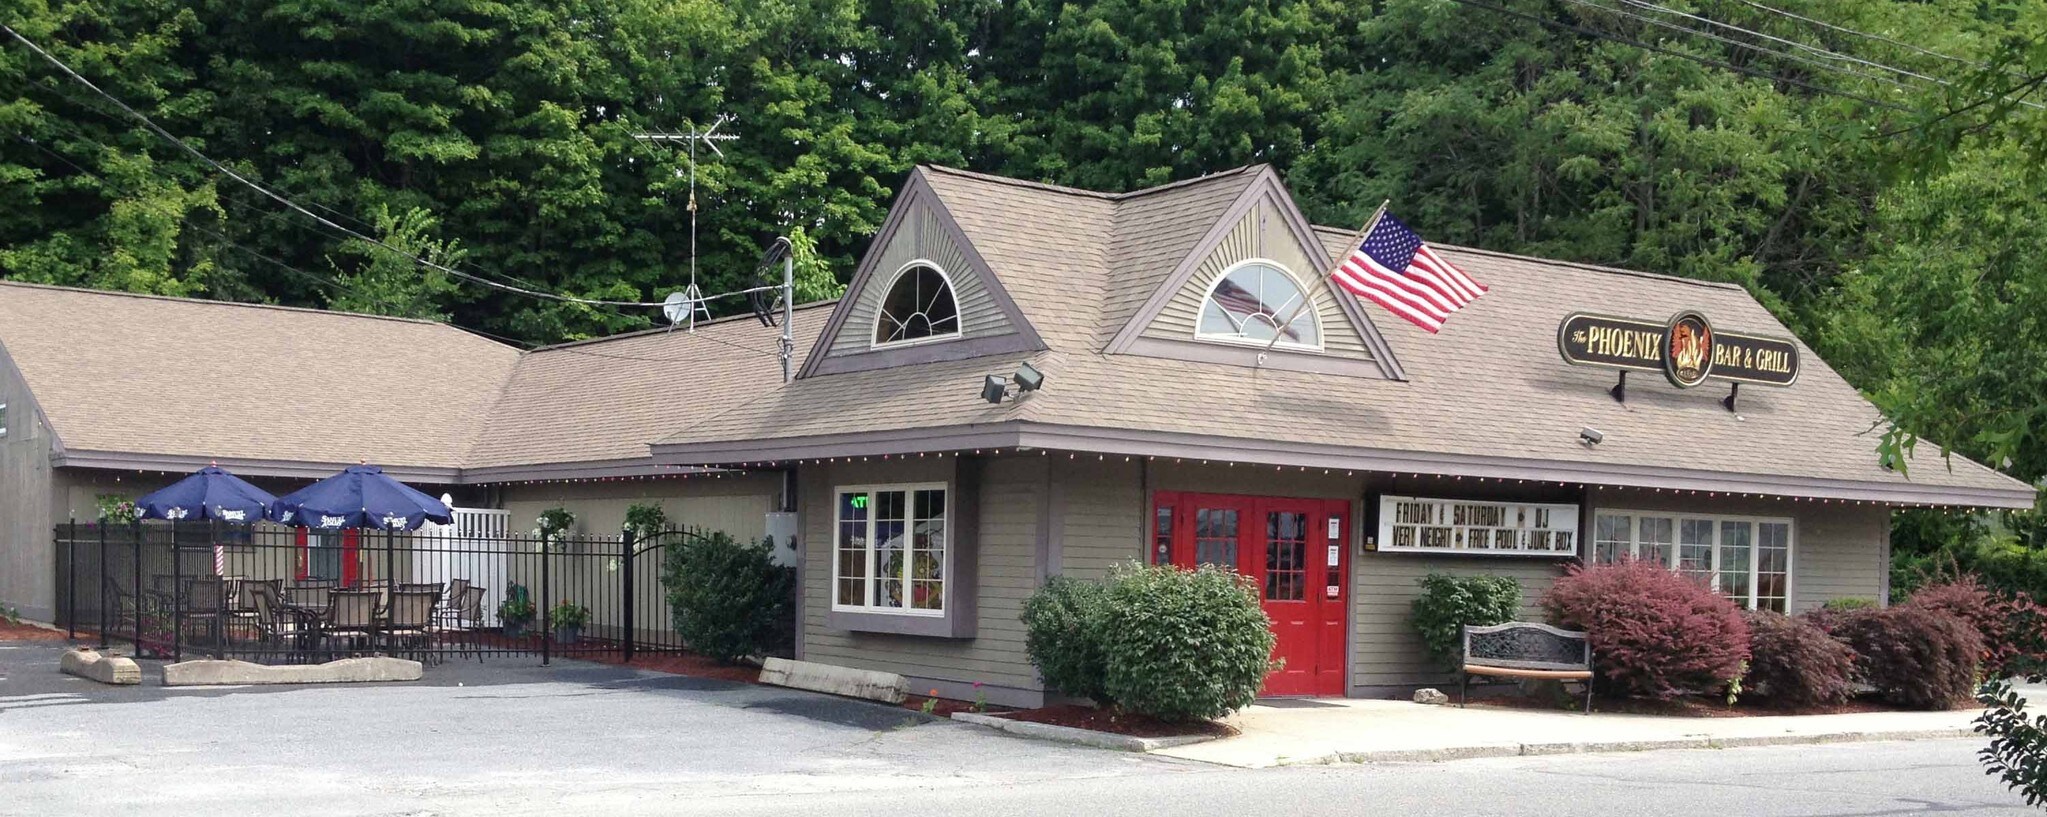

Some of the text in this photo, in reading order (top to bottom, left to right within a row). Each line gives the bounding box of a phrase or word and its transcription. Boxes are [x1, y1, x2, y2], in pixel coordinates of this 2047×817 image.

[1572, 325, 1791, 374] The PHOENIX BAR & GRILL
[1396, 502, 1434, 525] FRIDAY
[1453, 504, 1507, 527] SATURDAY
[1535, 507, 1550, 528] DJ
[1393, 525, 1417, 547] VERY
[1420, 526, 1453, 548] NEIGHT
[1468, 528, 1490, 549] FREE
[1494, 529, 1518, 550] POOL
[1527, 530, 1552, 550] JUKE
[1555, 531, 1573, 551] BOX
